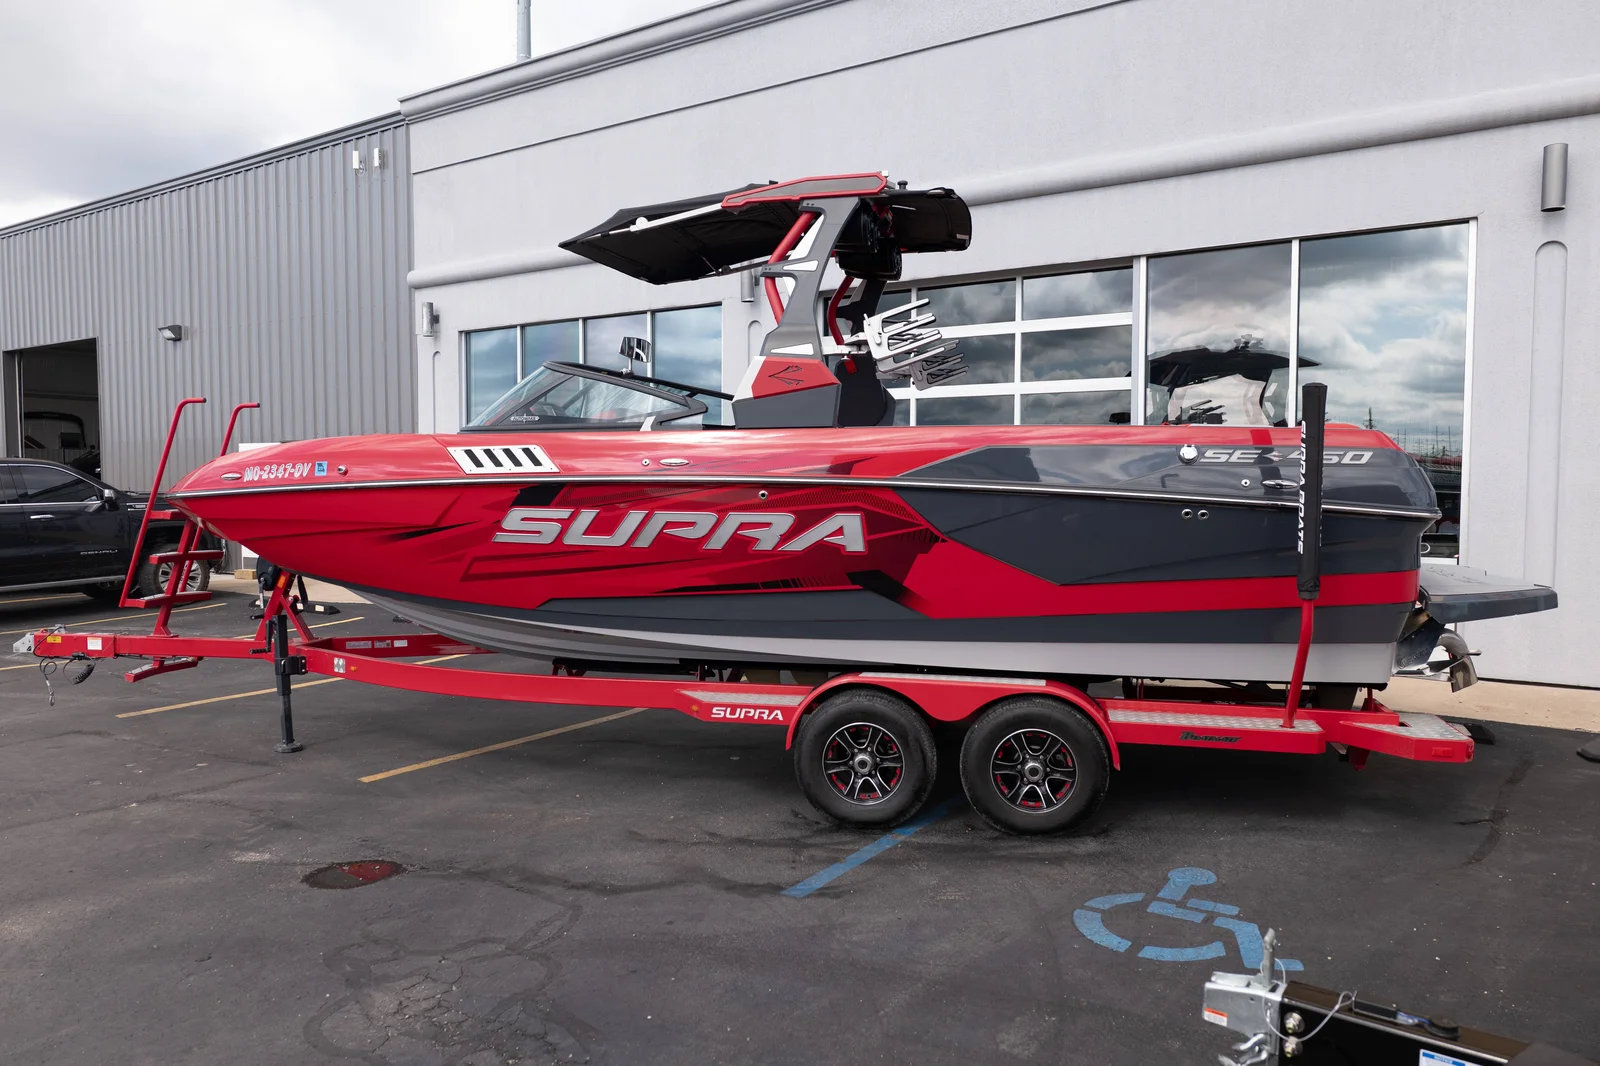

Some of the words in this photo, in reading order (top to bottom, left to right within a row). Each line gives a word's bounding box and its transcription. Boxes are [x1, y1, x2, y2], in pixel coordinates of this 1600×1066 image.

[1200, 449, 1263, 463] SE
[491, 507, 866, 552] SUPRA
[710, 706, 784, 721] SUPRA
